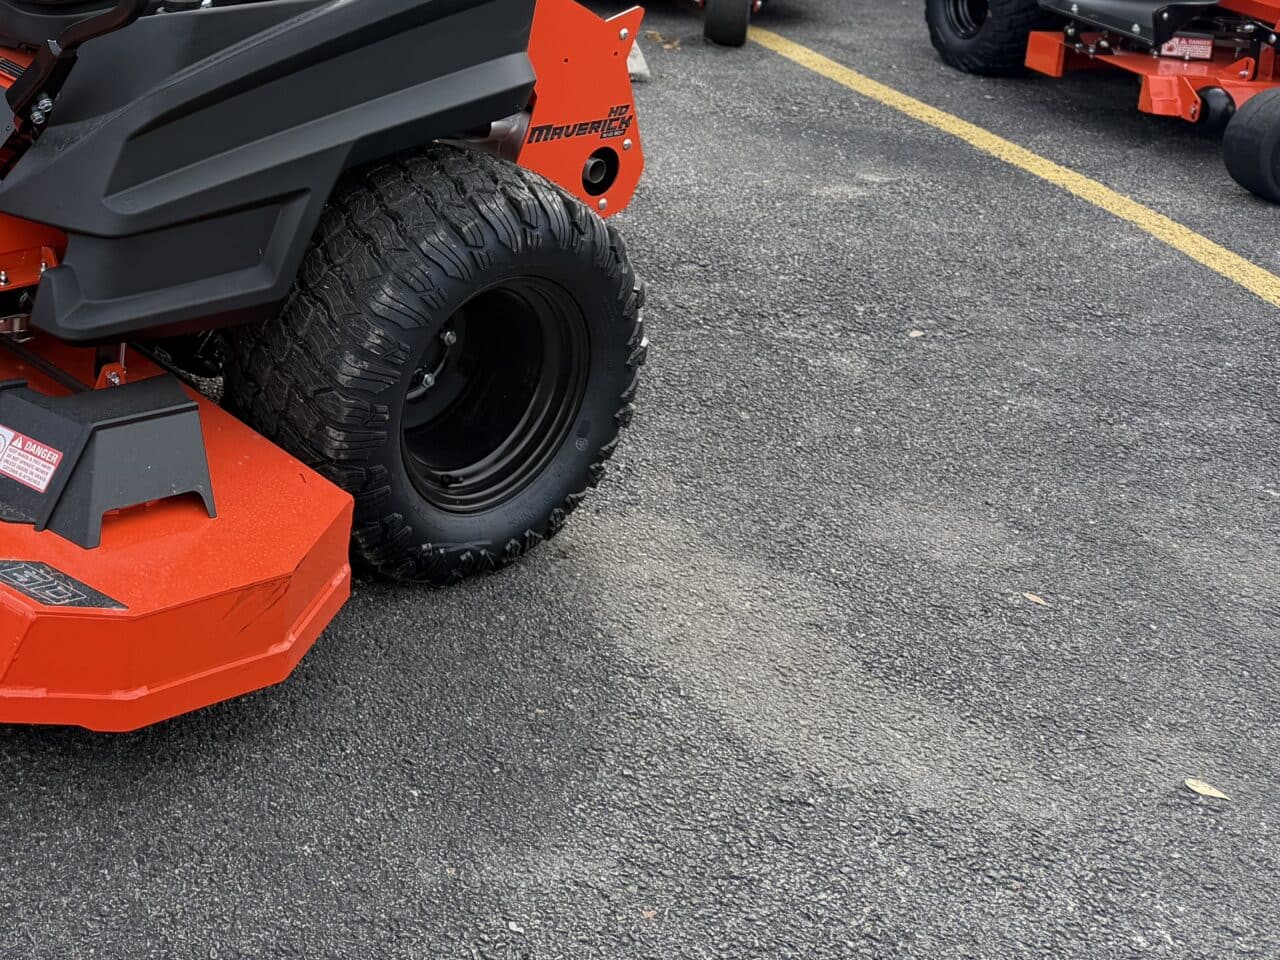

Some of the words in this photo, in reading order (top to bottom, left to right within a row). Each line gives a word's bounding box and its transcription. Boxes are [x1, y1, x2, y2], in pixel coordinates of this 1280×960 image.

[607, 104, 631, 118] HD
[526, 114, 634, 145] MAVERICK
[23, 441, 59, 464] DANGER
